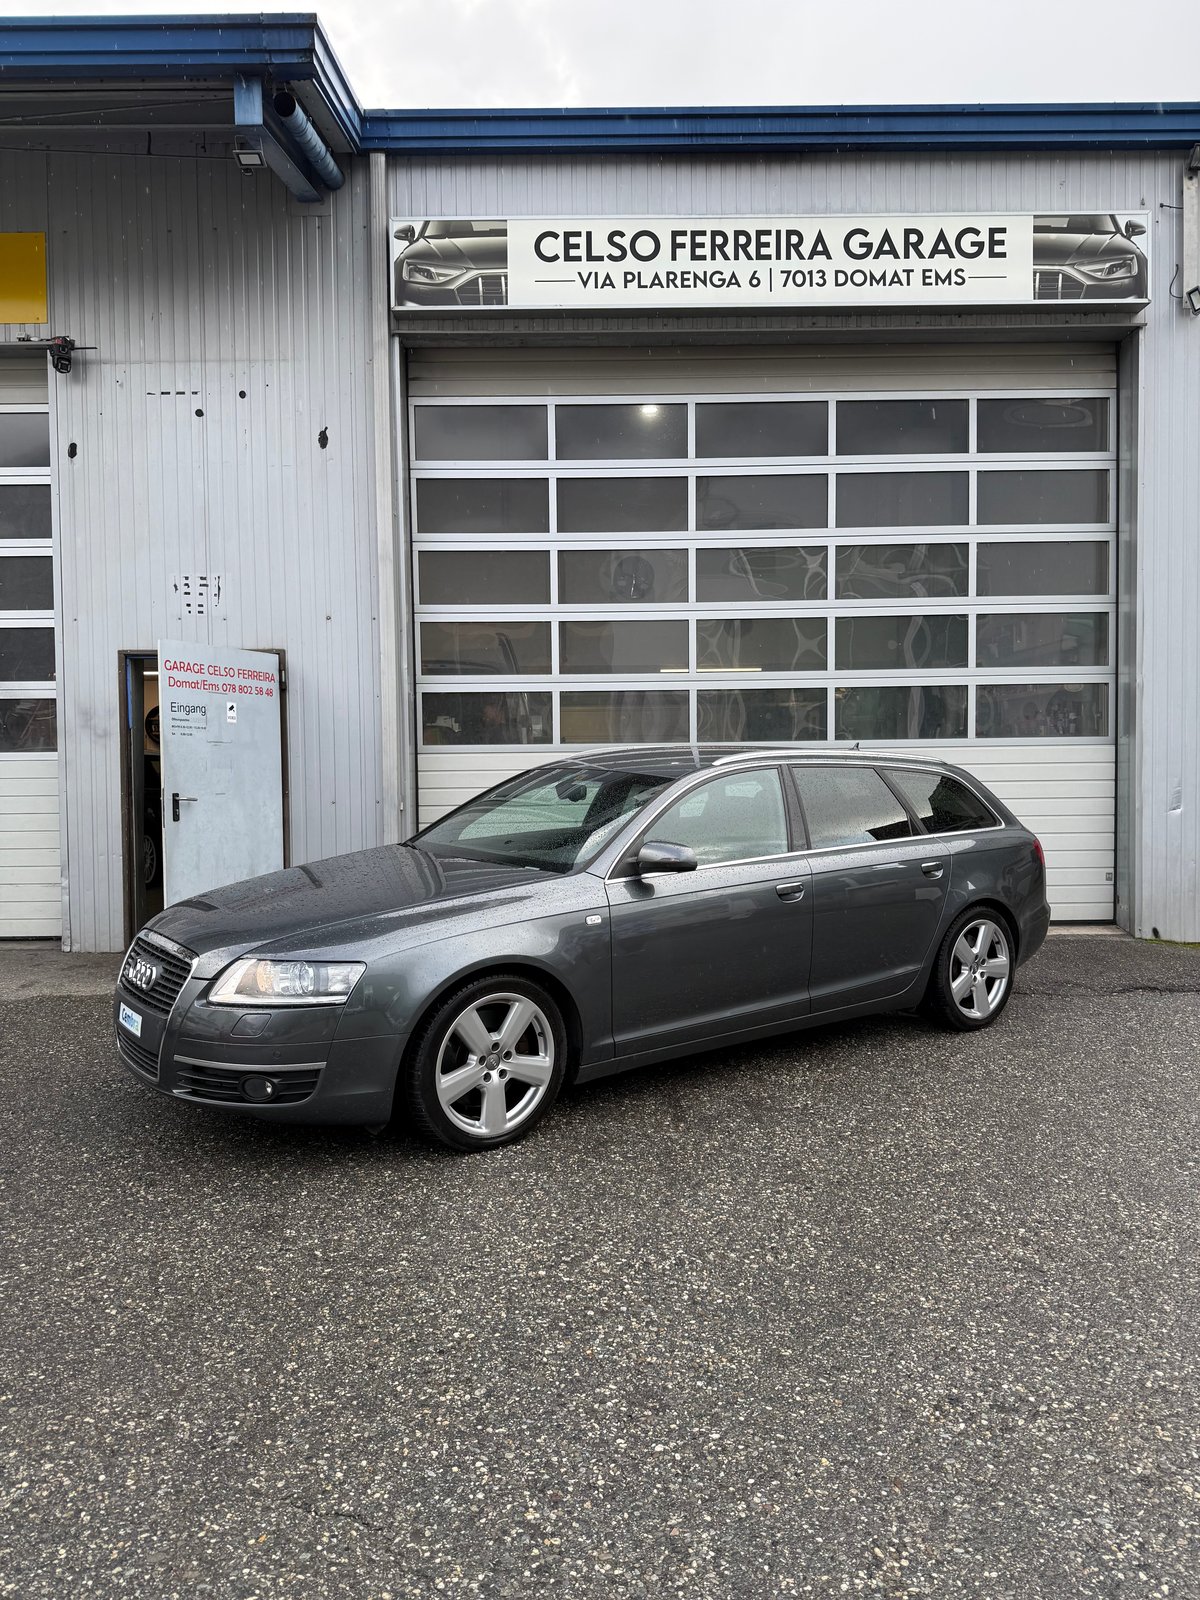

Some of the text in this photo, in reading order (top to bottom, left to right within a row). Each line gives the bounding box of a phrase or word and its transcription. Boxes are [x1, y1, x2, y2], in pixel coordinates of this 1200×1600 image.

[534, 227, 1007, 263] CELSO FERREIRA GARAGE
[578, 271, 615, 289] VIA
[624, 270, 741, 289] PLARENGA
[749, 271, 760, 288] 6
[781, 269, 827, 288] 7013
[835, 269, 915, 287] DOMAT
[922, 268, 965, 286] EMS
[164, 659, 276, 683] GARAGE CELSO FERREIRA
[168, 676, 274, 697] Domat/Ems 078 802 58 48
[170, 701, 207, 716] Eingang
